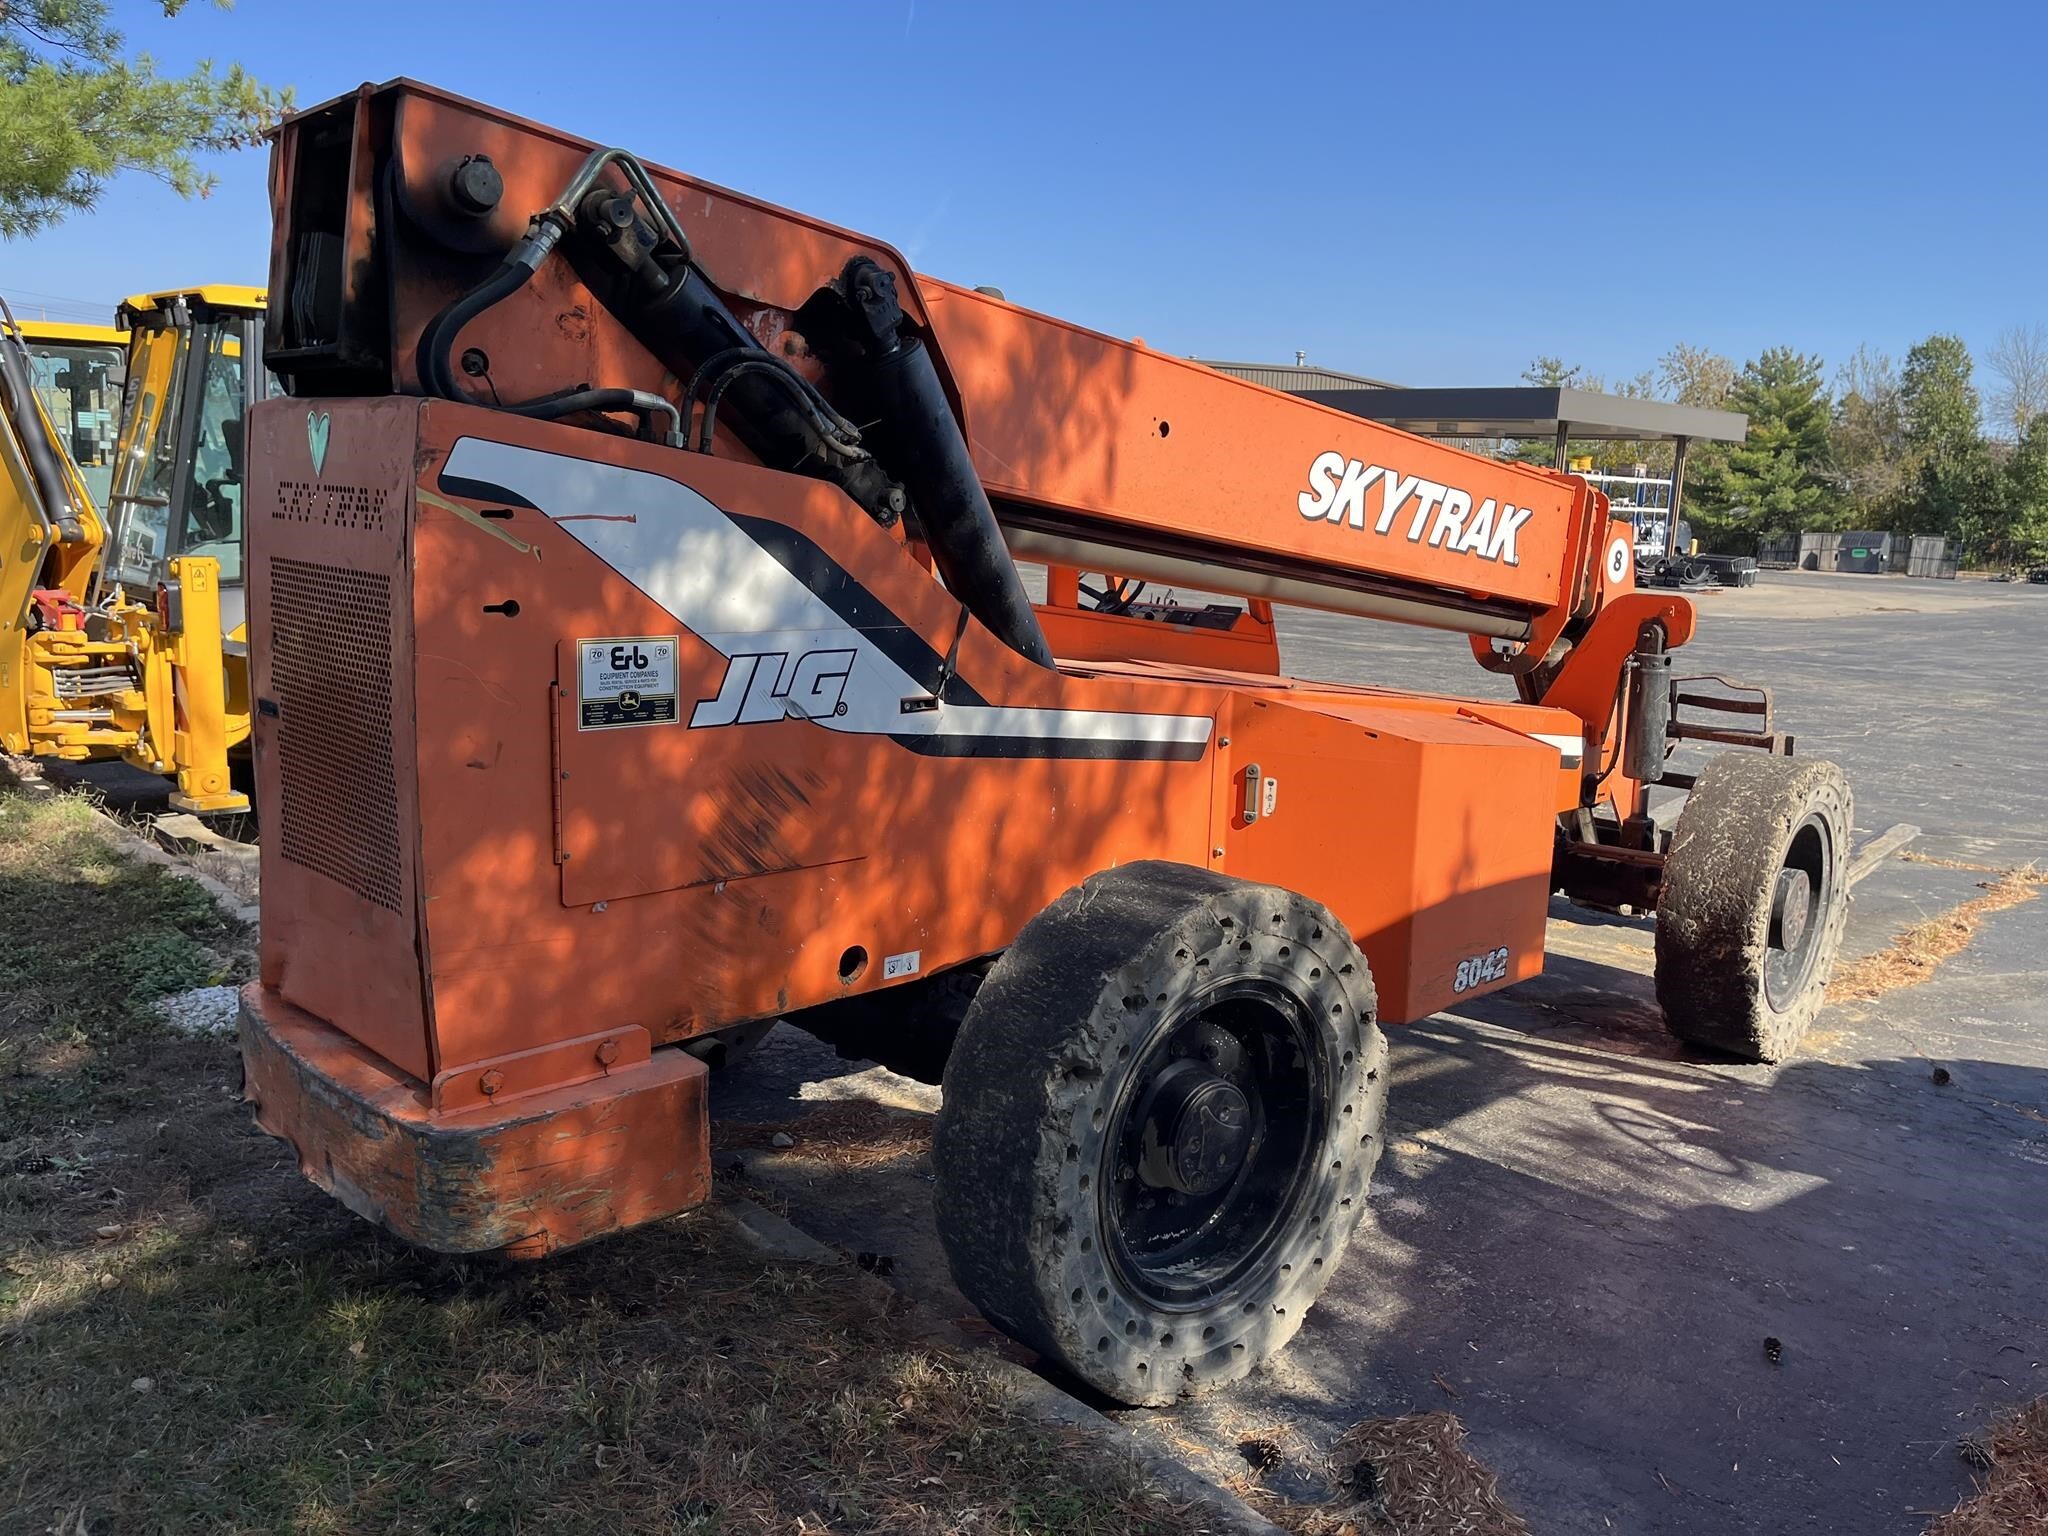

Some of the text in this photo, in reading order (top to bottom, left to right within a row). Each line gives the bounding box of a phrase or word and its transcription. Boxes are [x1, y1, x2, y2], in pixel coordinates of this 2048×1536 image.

[272, 481, 387, 532] SKYTRAK
[1298, 450, 1533, 567] SKYTRAK
[1612, 550, 1623, 572] 8
[600, 670, 659, 680] EQUIPMENT COMPANIES
[611, 645, 649, 671] Erb
[687, 649, 858, 729] JLG
[1452, 945, 1509, 995] 8042
